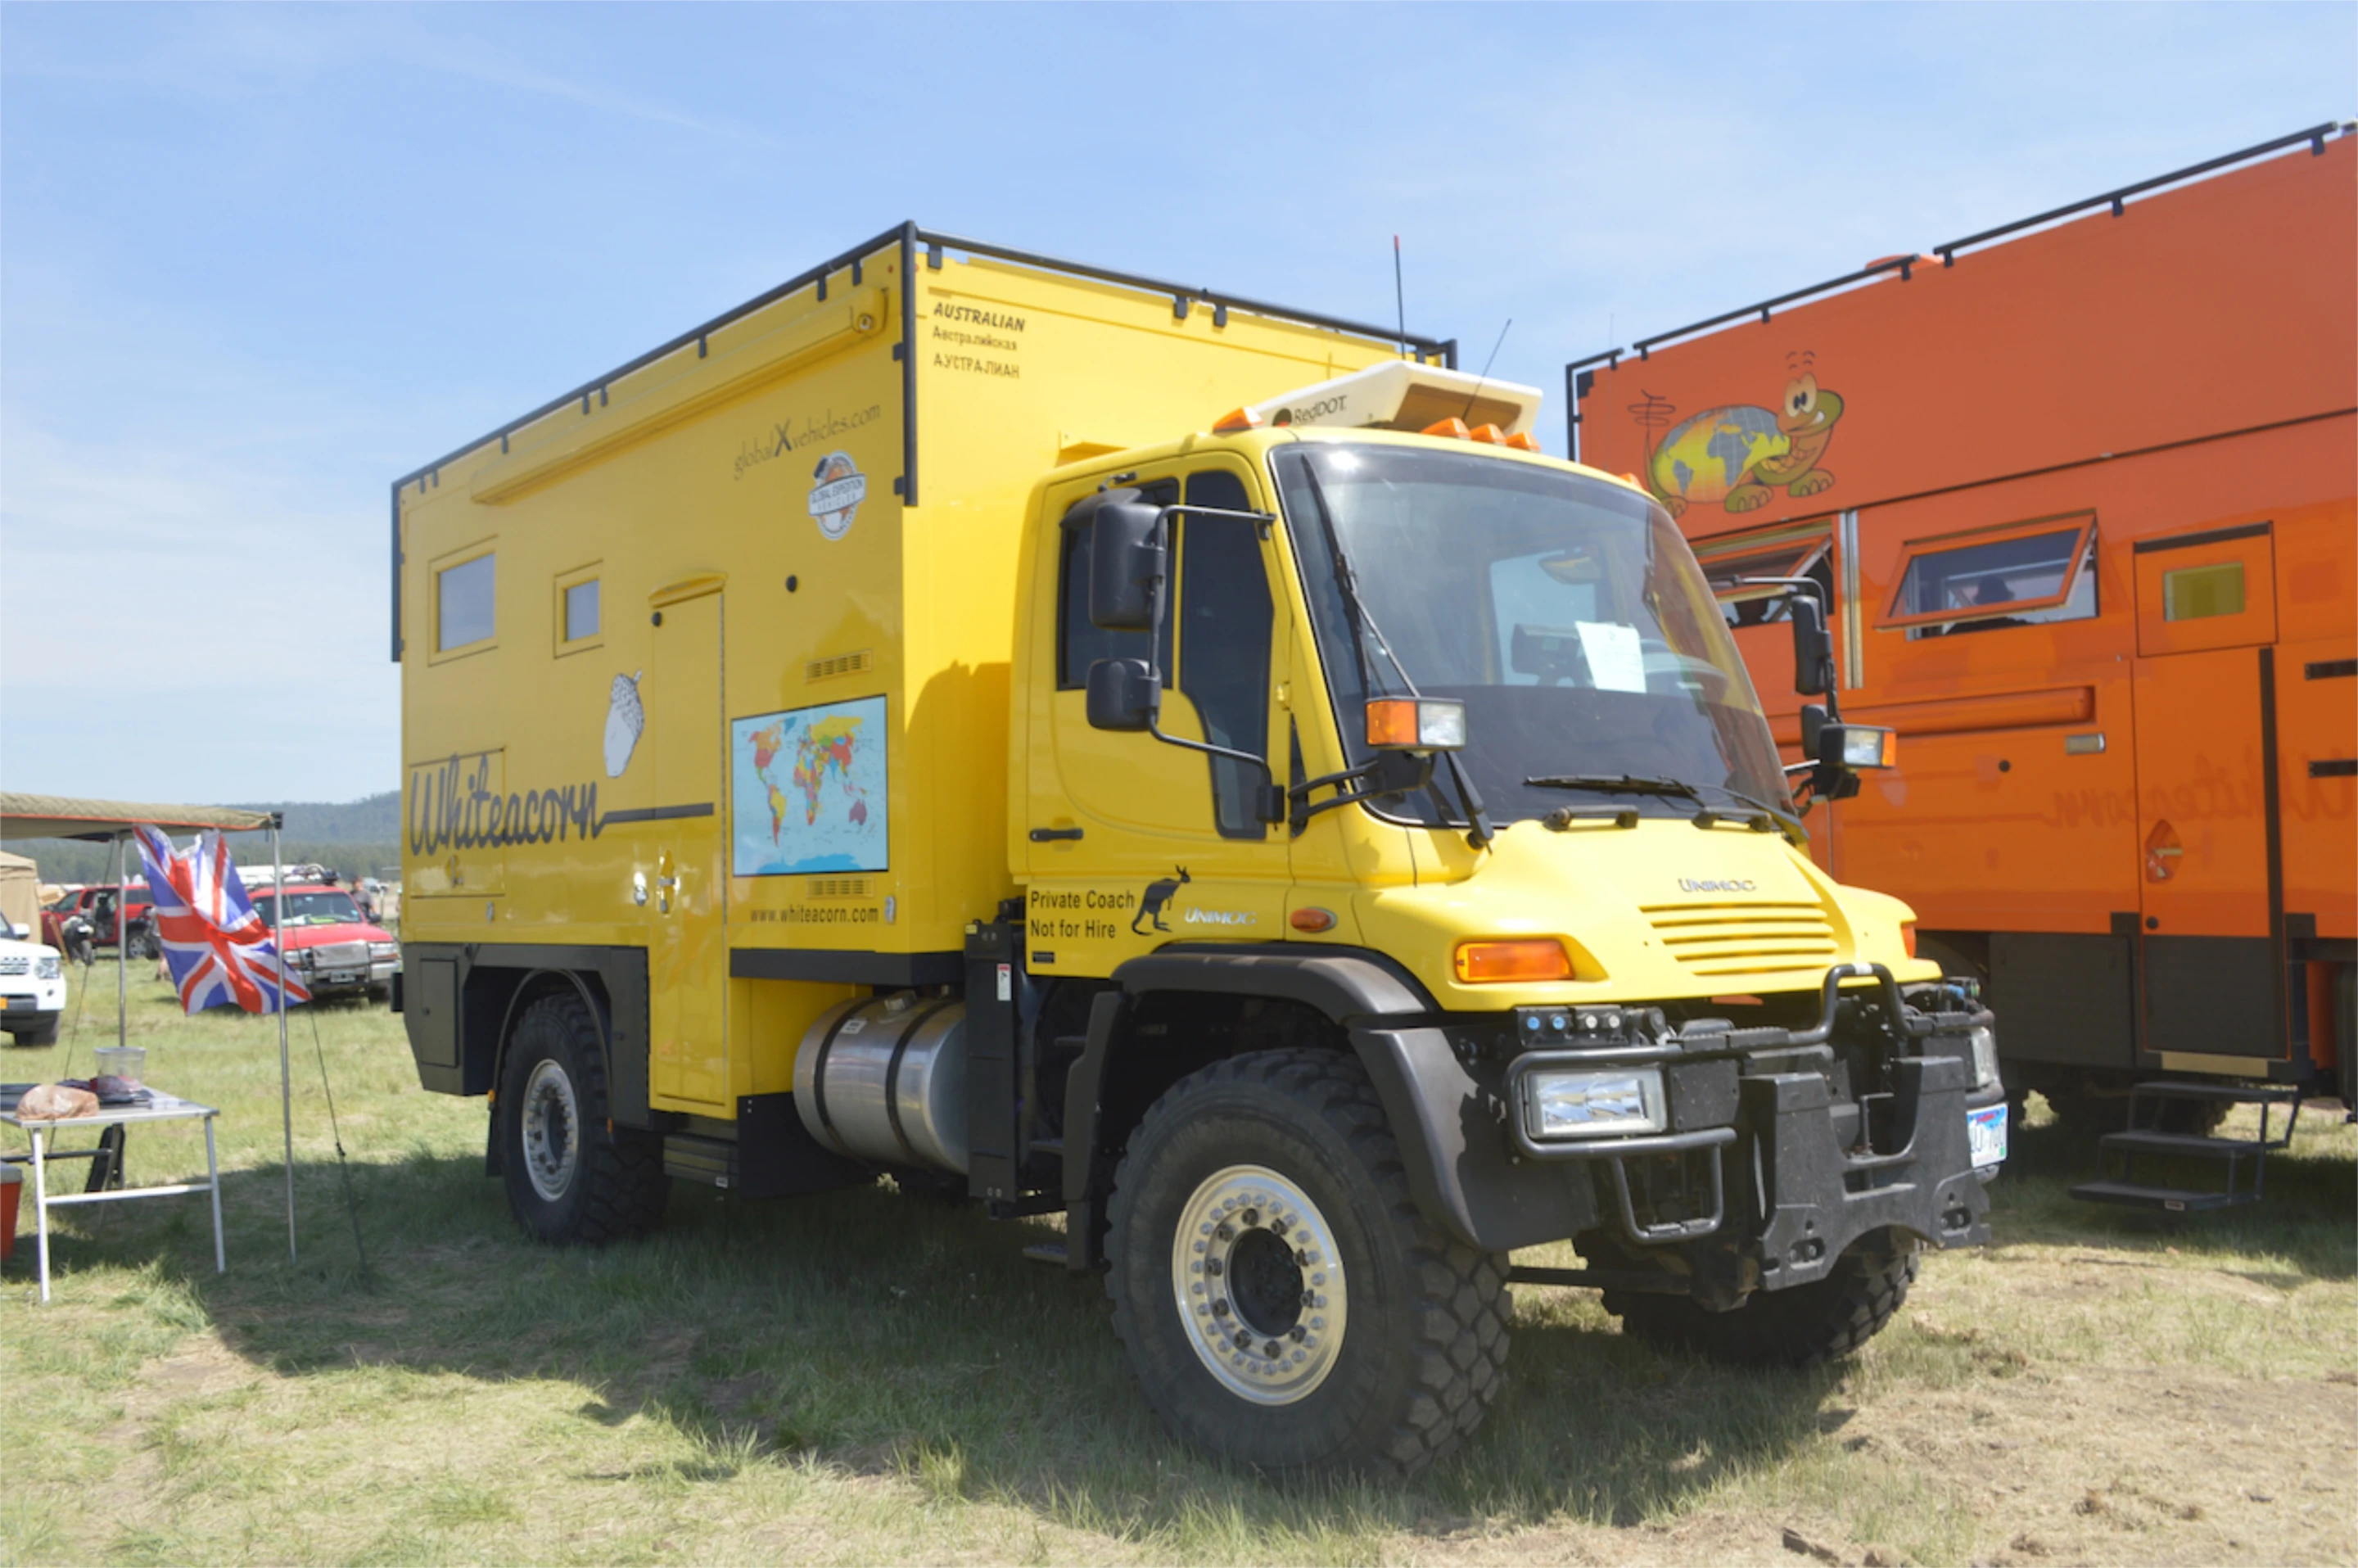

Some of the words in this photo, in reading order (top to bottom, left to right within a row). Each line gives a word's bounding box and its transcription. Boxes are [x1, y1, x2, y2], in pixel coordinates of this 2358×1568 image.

[933, 301, 1026, 332] AUSTRALIAN
[933, 353, 1020, 379] АУСТРАЛИАН
[411, 752, 608, 856] Whiteacorn
[1031, 889, 1081, 909] Private
[1086, 889, 1136, 909] Coach
[751, 904, 879, 923] www.whiteacorn.com
[1185, 906, 1258, 926] UNIMOG
[1030, 919, 1055, 938] Not
[1059, 919, 1080, 938] for
[1085, 919, 1117, 939] Hire
